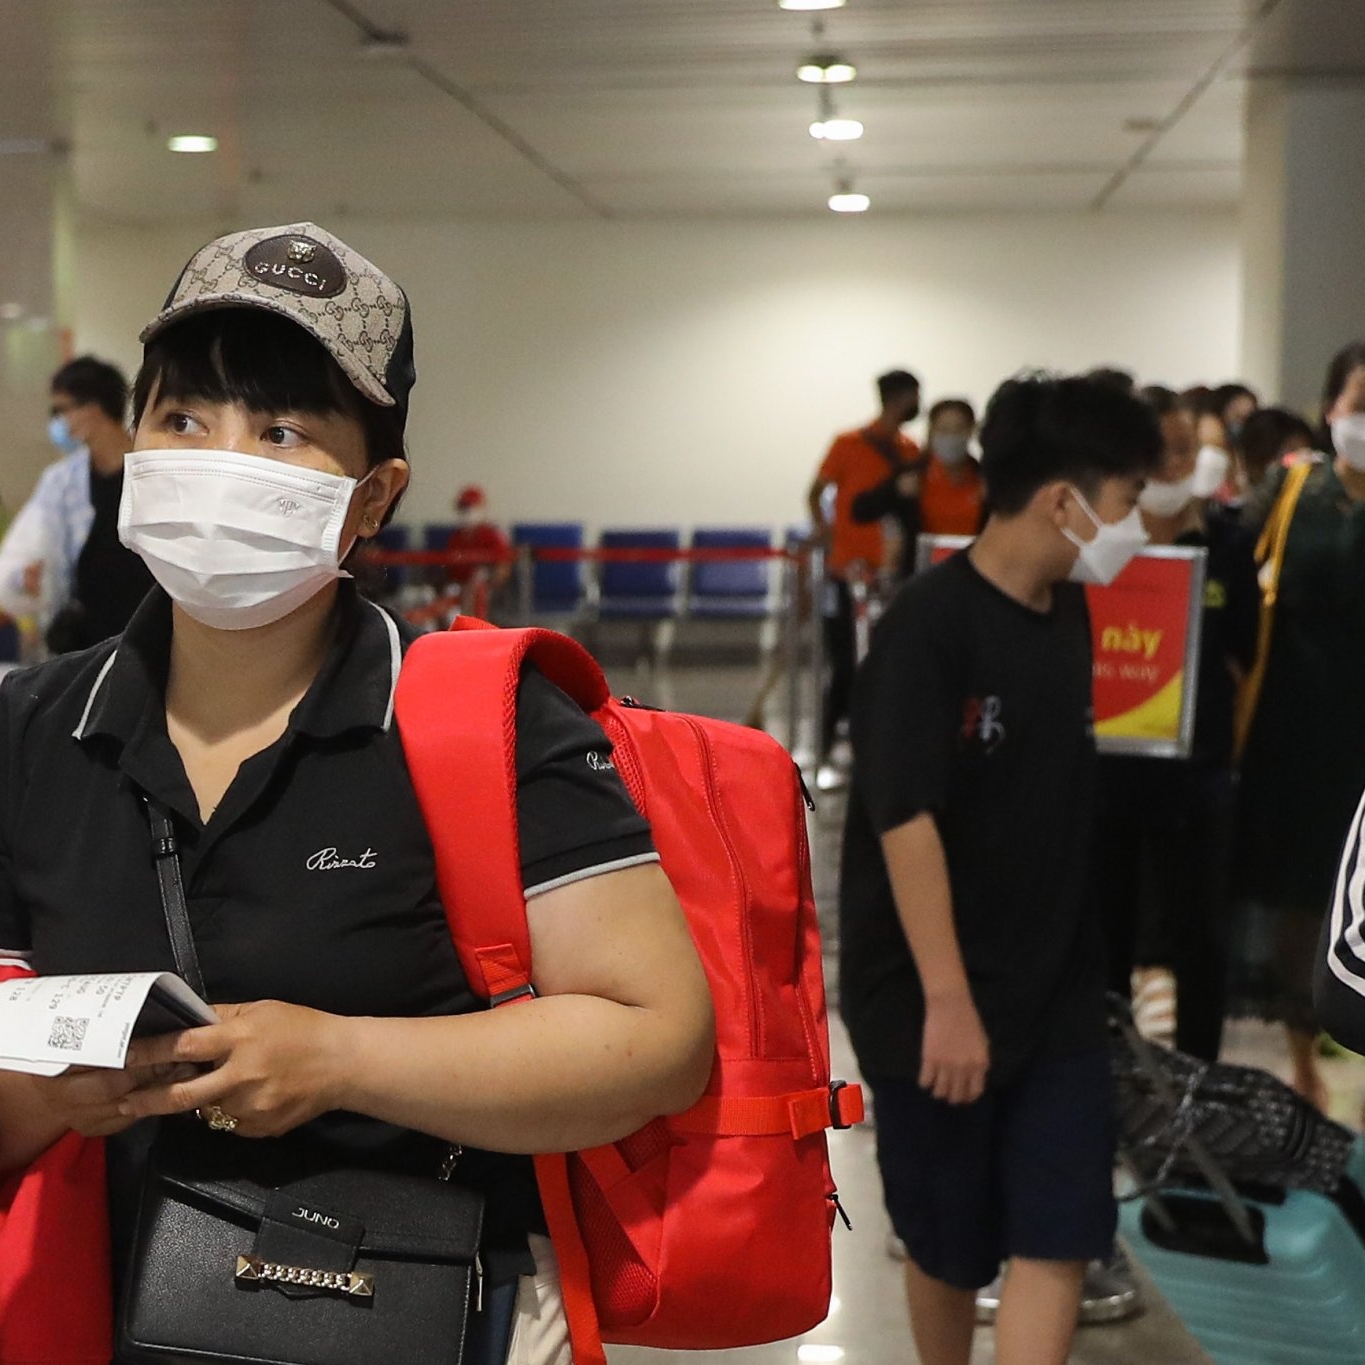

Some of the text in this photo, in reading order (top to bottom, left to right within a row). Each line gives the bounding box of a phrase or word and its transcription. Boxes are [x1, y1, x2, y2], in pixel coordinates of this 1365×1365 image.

[255, 262, 326, 290] GUCCI
[1101, 622, 1163, 660] này
[291, 1207, 341, 1229] JUNO
